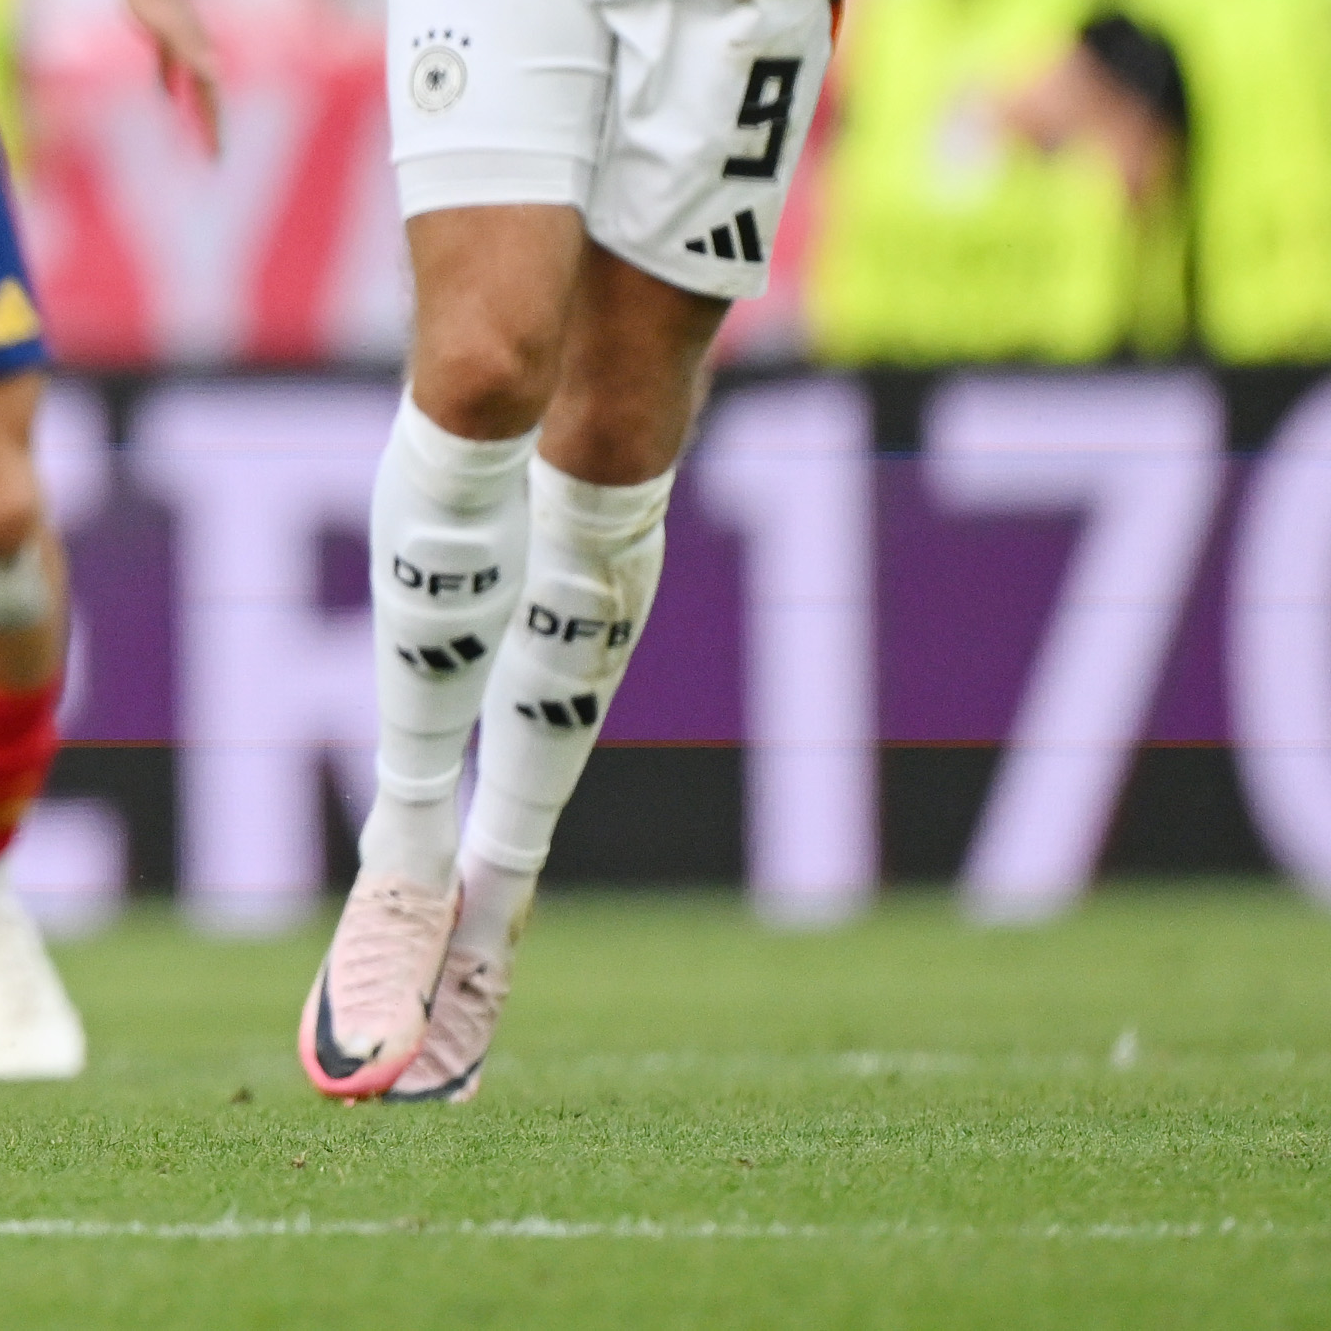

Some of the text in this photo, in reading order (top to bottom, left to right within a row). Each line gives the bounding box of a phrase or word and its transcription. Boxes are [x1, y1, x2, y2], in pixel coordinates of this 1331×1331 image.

[722, 57, 803, 182] 9
[394, 555, 502, 596] DFB
[529, 603, 632, 649] DFB
